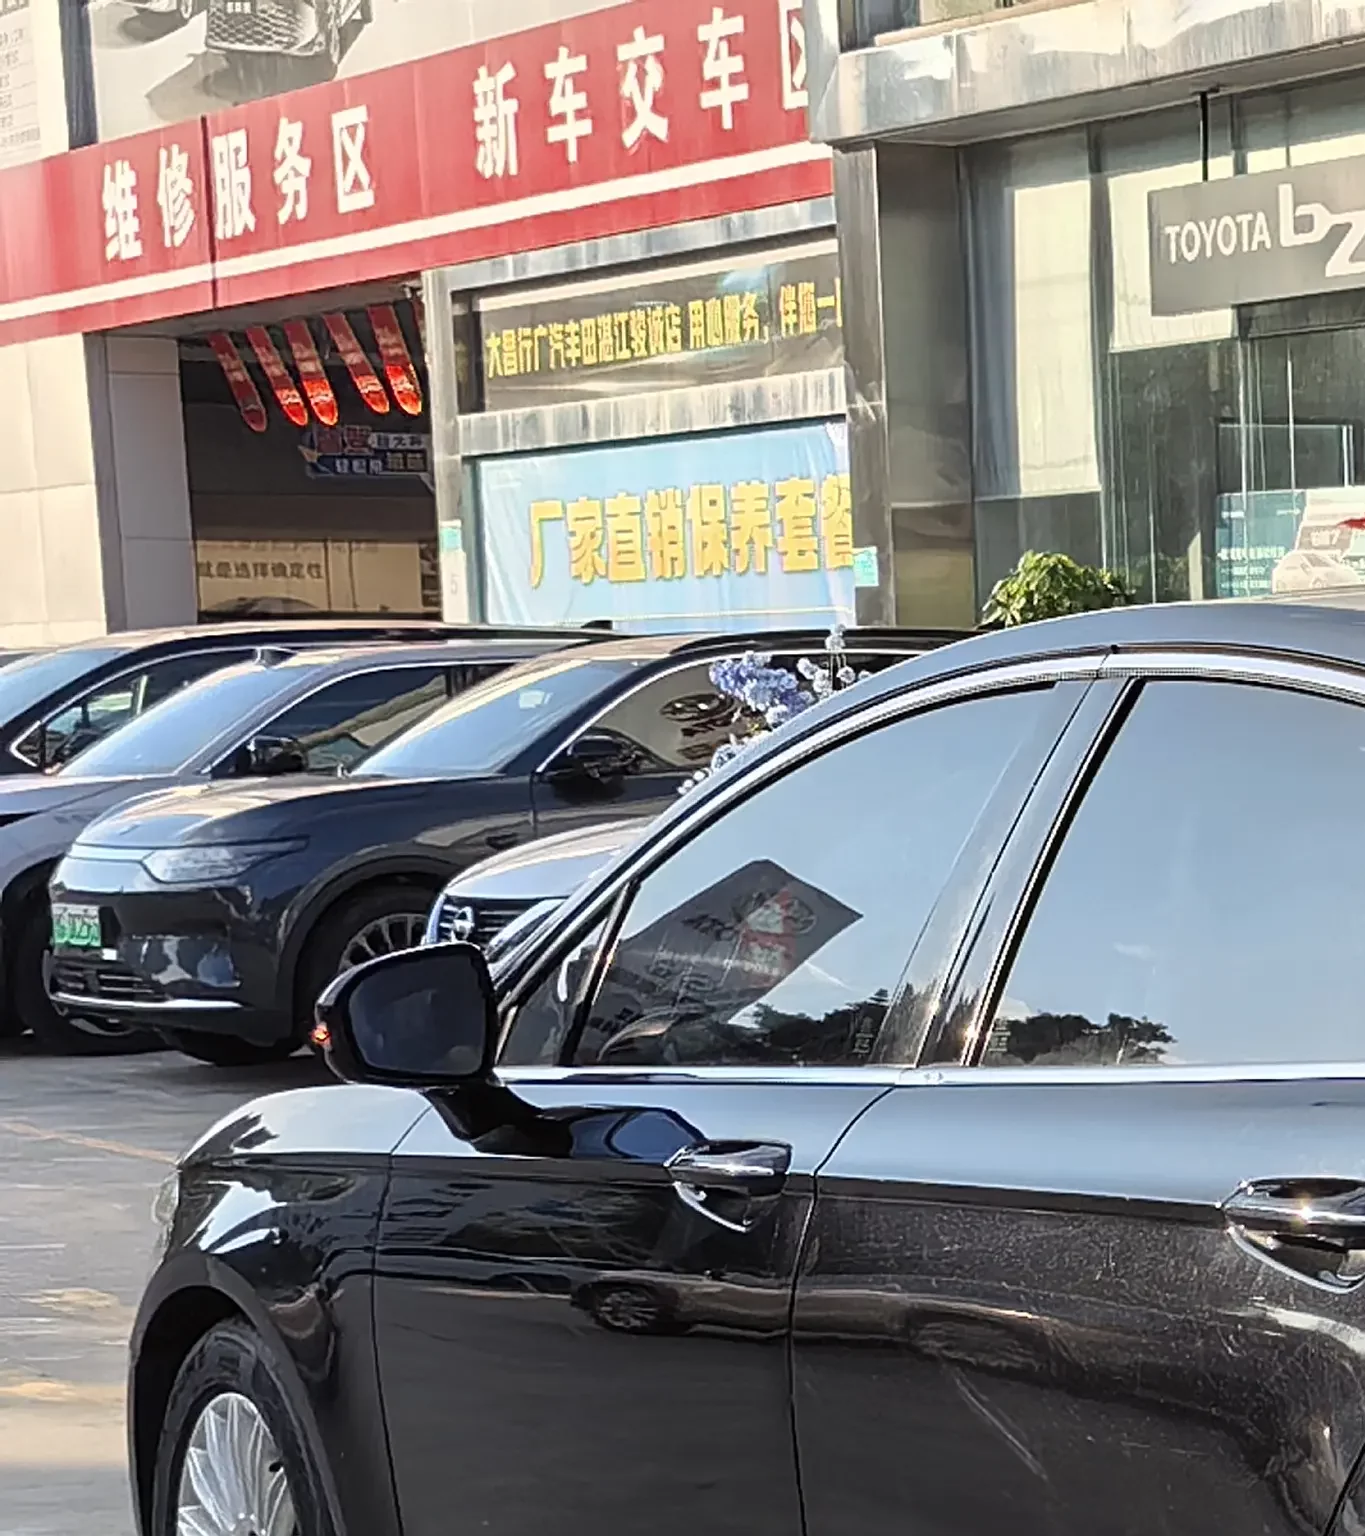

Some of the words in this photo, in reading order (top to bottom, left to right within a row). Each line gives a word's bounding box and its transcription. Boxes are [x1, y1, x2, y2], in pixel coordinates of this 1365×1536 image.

[102, 105, 376, 262] 维修服务区
[1163, 210, 1272, 265] TOYOTA
